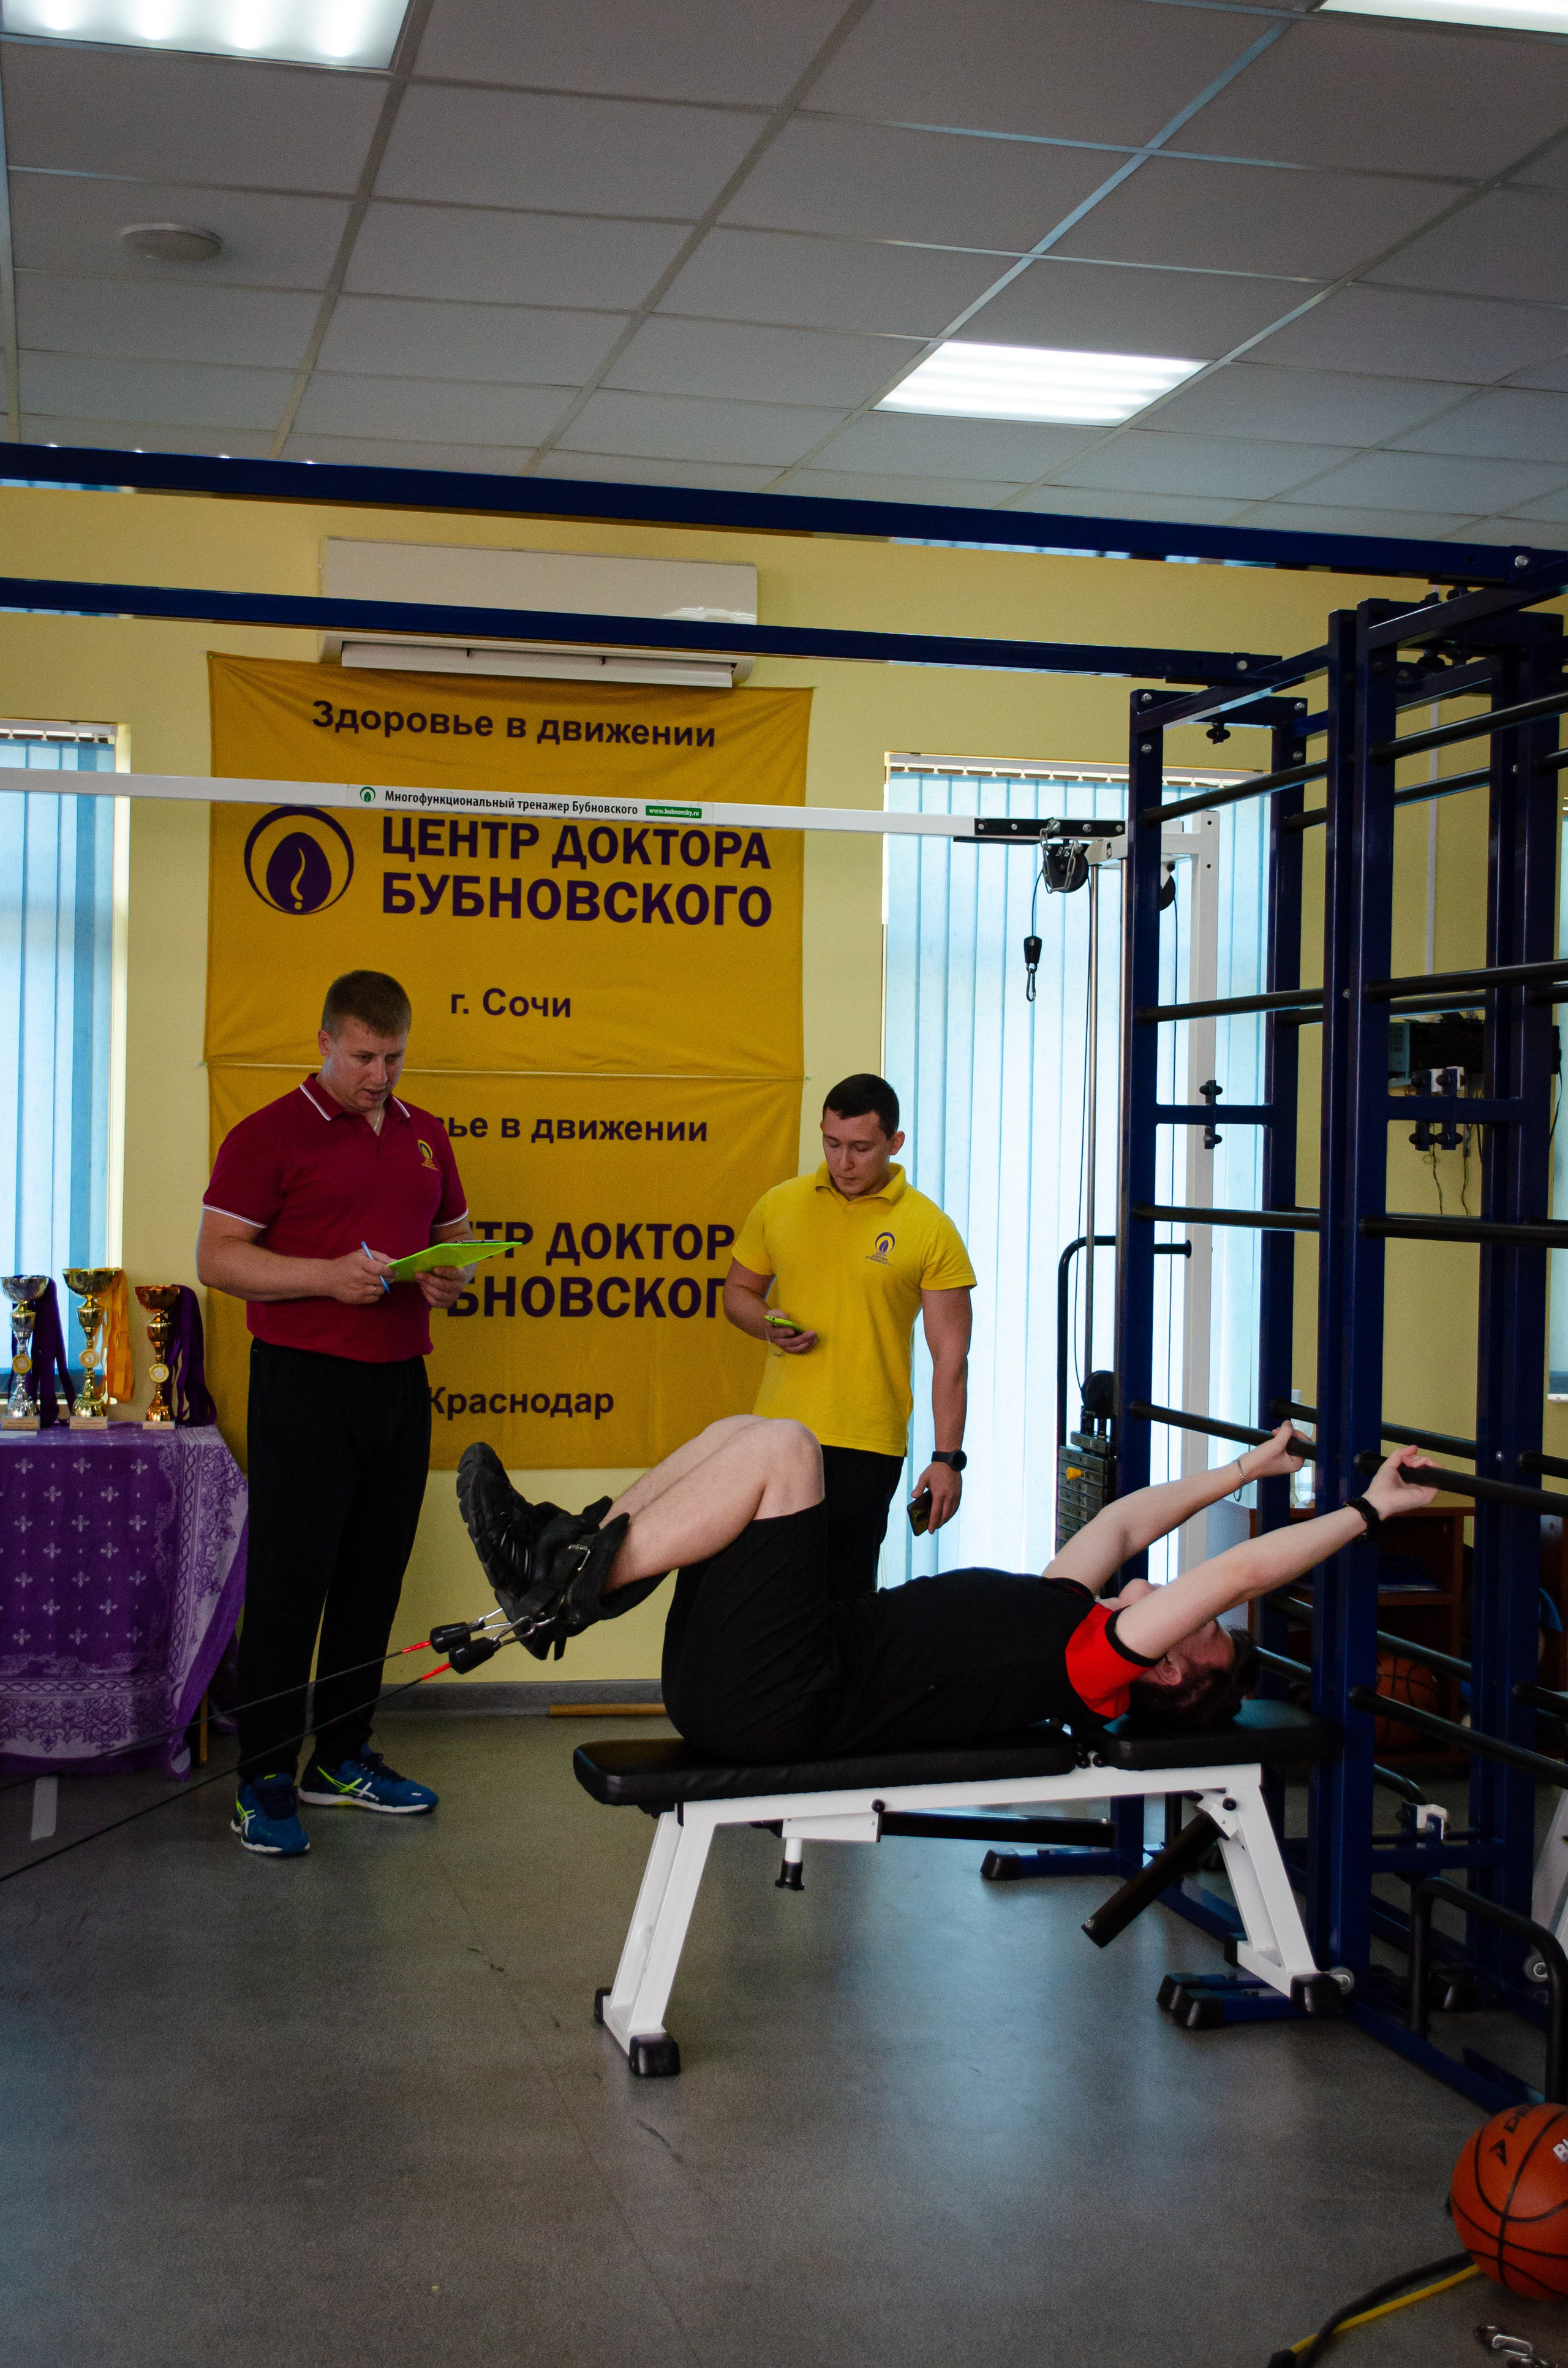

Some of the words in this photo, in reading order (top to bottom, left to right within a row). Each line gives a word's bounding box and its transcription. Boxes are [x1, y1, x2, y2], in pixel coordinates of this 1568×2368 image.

[313, 700, 493, 738] Здоровье
[507, 717, 526, 738] в
[537, 719, 715, 747] движении
[385, 790, 514, 808] Многофункциональный
[518, 800, 570, 814] тренажер
[573, 801, 638, 814] Бубновского
[649, 808, 699, 817] www.bubnovsky.ru
[383, 817, 540, 862] ЦЕНТР
[551, 825, 771, 870] ДОКТОРА
[383, 872, 772, 928] БУБНОВСКОГО
[451, 994, 469, 1014] г.
[483, 988, 571, 1018] Сочи
[437, 1117, 488, 1138] ье
[501, 1118, 521, 1138] в
[531, 1118, 708, 1143] движении
[545, 1222, 734, 1266] ДОКТОР
[429, 1386, 614, 1421] Краснодар
